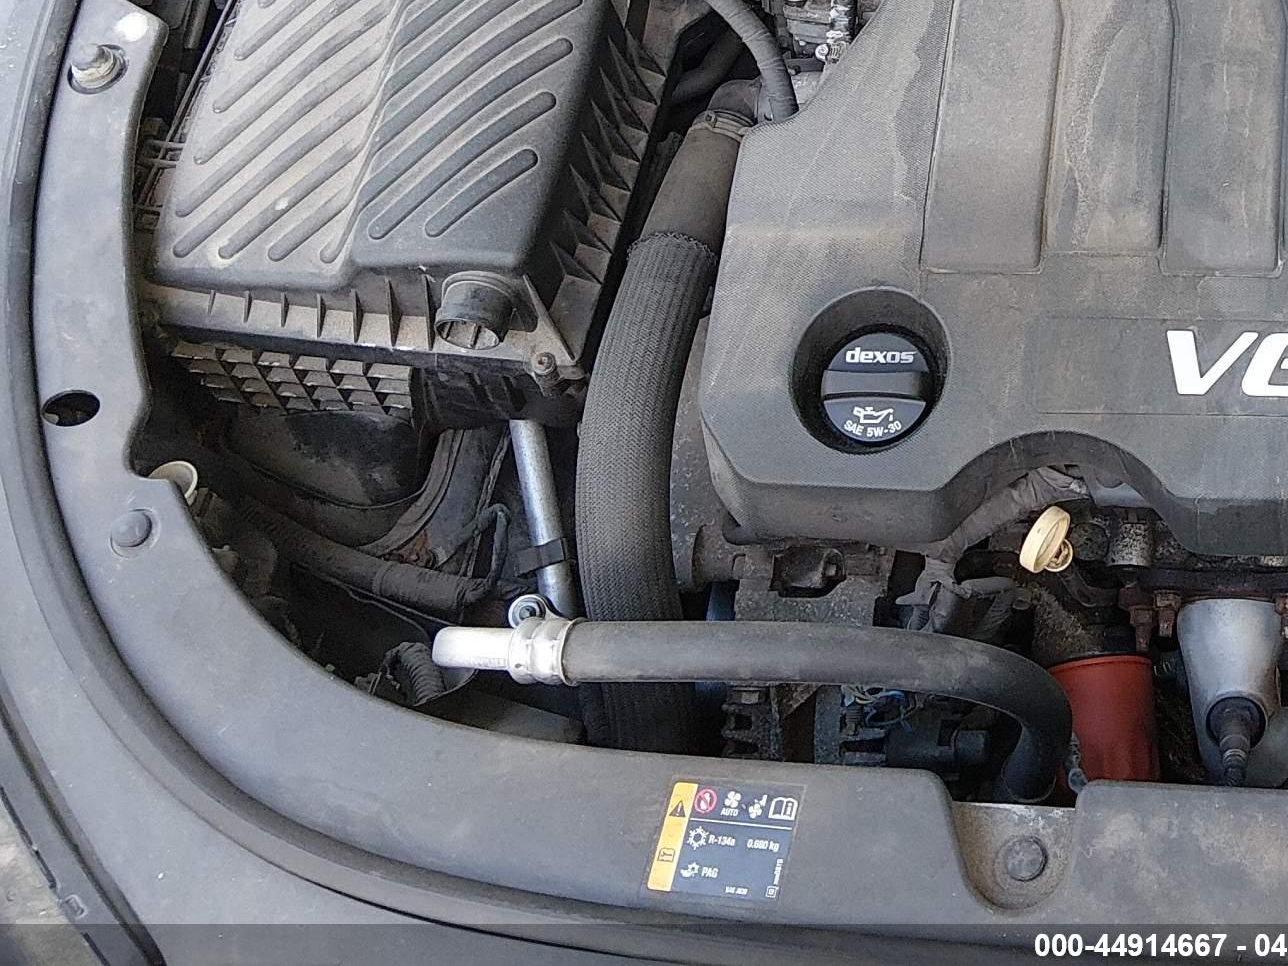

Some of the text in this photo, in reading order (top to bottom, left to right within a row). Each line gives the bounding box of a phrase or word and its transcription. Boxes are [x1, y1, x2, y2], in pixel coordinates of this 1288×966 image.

[845, 347, 918, 364] dexos
[843, 420, 902, 437] SAE 5W-30
[720, 808, 739, 817] AUTO
[769, 841, 780, 853] kg
[701, 866, 719, 878] PAG
